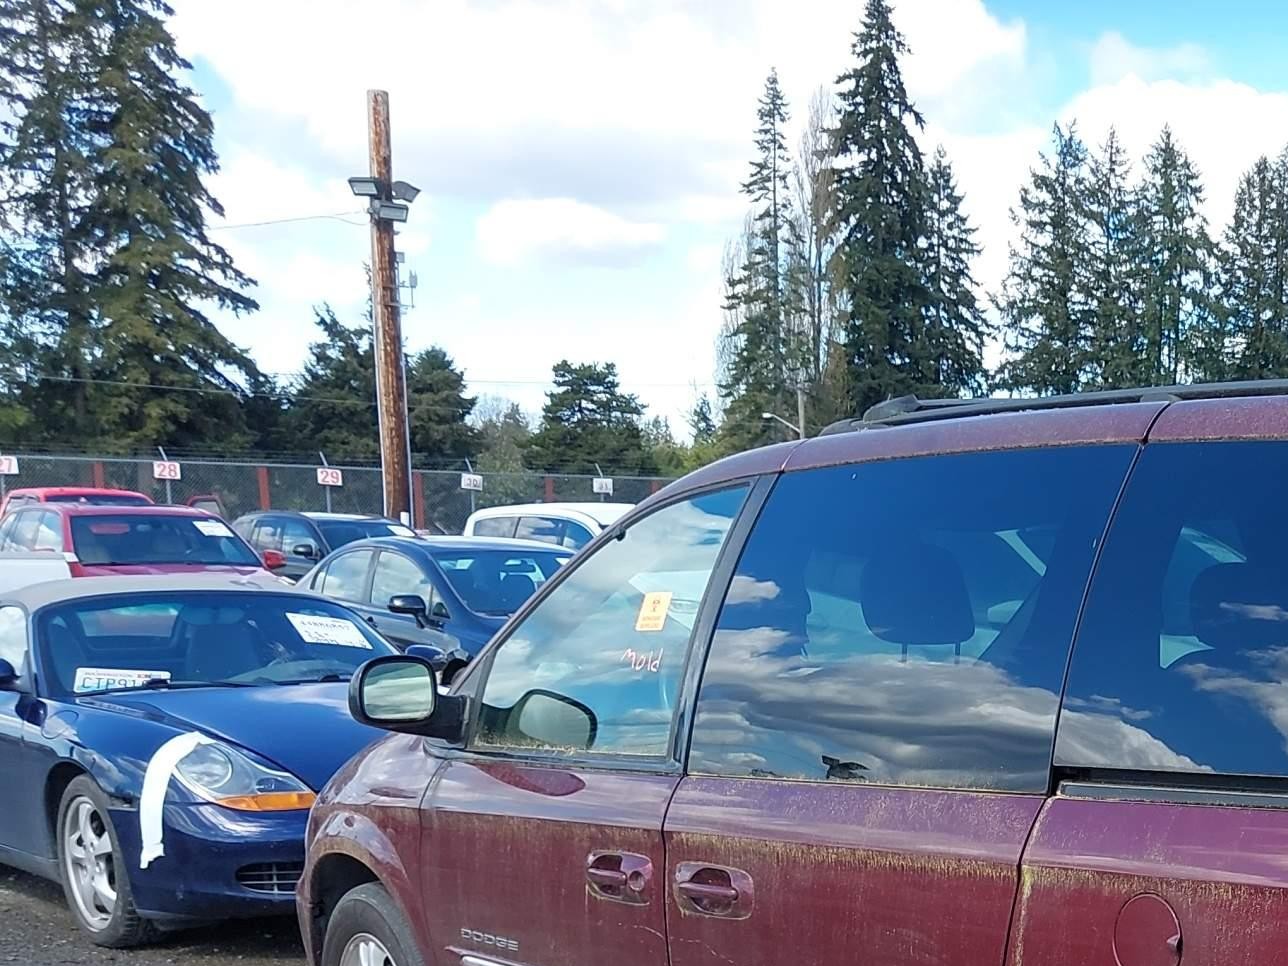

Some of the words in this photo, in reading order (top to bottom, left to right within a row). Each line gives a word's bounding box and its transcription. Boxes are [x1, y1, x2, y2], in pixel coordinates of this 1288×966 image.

[157, 463, 177, 478] 28
[320, 470, 340, 484] 29
[82, 676, 146, 690] CTP91
[460, 928, 519, 951] DODGE
